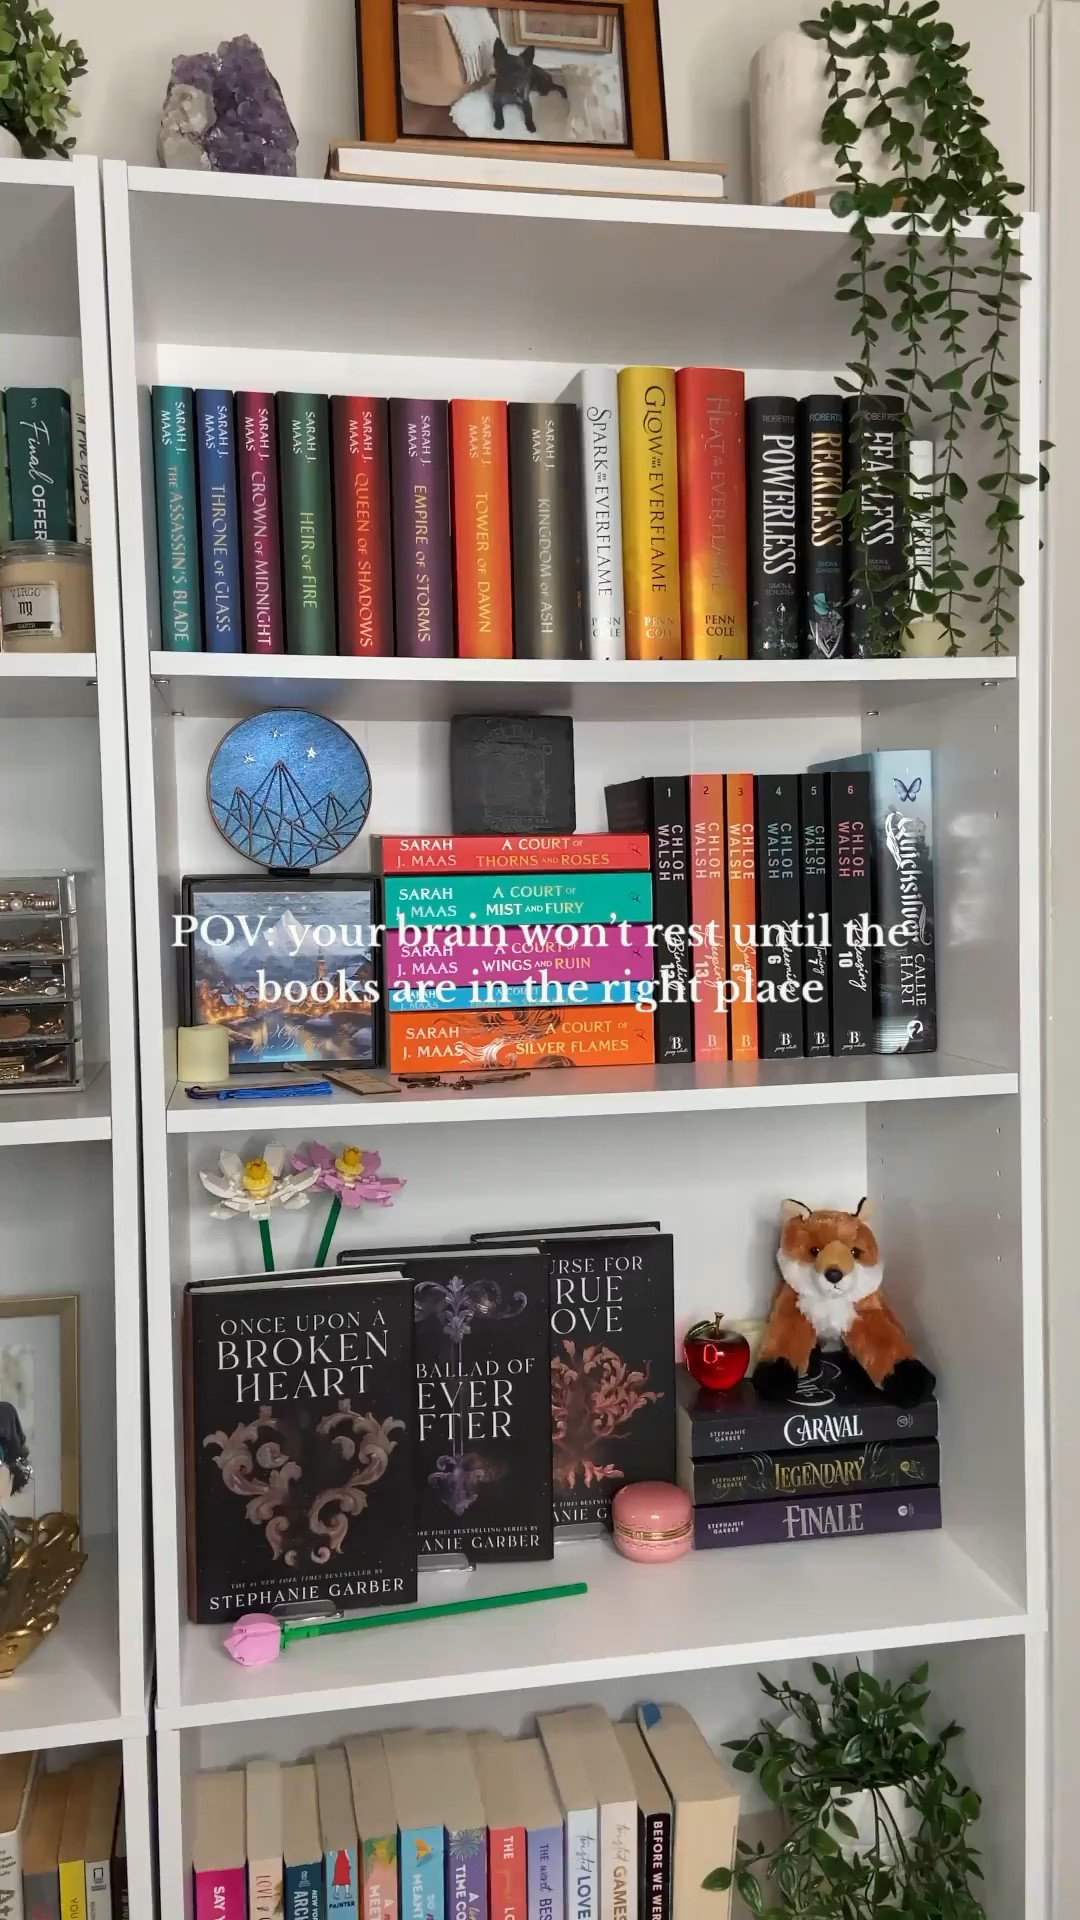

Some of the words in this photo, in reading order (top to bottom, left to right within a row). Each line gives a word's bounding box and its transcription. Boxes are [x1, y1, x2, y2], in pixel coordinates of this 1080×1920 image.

[161, 410, 172, 446] MAAS
[175, 402, 186, 442] SARAH
[205, 414, 216, 449] MAAS
[218, 406, 229, 446] SARAH
[245, 416, 256, 452] MAAS
[258, 408, 270, 449] SARAH
[292, 420, 303, 455] MAAS
[306, 412, 317, 451] SARAH
[349, 420, 360, 455] MAAS
[362, 412, 373, 451] SARAH
[420, 416, 432, 454] SARAH
[482, 416, 492, 456] SARAH
[586, 406, 612, 471] SPARK
[643, 386, 666, 456] GLOW
[20, 420, 54, 484] Final
[175, 447, 187, 455] J.
[217, 450, 229, 459] J.
[258, 452, 270, 461] J.
[408, 423, 418, 458] MAAS
[468, 424, 479, 459] MAAS
[532, 428, 542, 463] MAAS
[545, 420, 555, 459] SARAH
[305, 455, 317, 464] J.
[362, 454, 373, 463] J.
[168, 465, 178, 488] THE
[811, 432, 844, 547] RECKLESS
[32, 484, 48, 540] OFFER
[252, 471, 268, 538] CROWN
[354, 472, 370, 532] QUEEN
[414, 485, 429, 545] EMPIRE
[762, 434, 796, 575] POWERLESS
[170, 490, 187, 584] ASSASSIN'S
[212, 484, 228, 556] THRONE
[300, 512, 315, 550] HEIR
[476, 492, 490, 552] TOWER
[649, 472, 667, 593] EVERFLAME
[538, 498, 552, 578] KINGDOM
[595, 486, 613, 596] EVERFLAME
[9, 587, 42, 598] VIRGO
[214, 582, 231, 632] GLASS
[254, 560, 271, 646] MIDNIGHT
[302, 576, 318, 609] FIRE
[358, 561, 373, 647] SHADOWS
[416, 574, 431, 642] STORMS
[478, 582, 492, 633] DAWN
[173, 590, 189, 642] BLADE
[540, 602, 554, 633] ASH
[706, 614, 735, 625] PENN
[706, 626, 735, 637] COLE
[704, 786, 709, 795] 2
[738, 788, 744, 797] 3
[776, 786, 782, 796] 4
[811, 786, 817, 796] 5
[848, 785, 854, 795] 6
[400, 838, 453, 851] SARAH
[411, 855, 457, 867] MAAS
[476, 854, 539, 868] THORNS
[560, 854, 610, 866] ROSES
[502, 839, 513, 851] A
[518, 837, 571, 851] COURT
[658, 824, 671, 881] WALSH
[672, 824, 684, 881] CHLOE
[694, 822, 707, 879] WALSH
[708, 822, 721, 879] CHLOE
[729, 824, 742, 880] WALSH
[742, 824, 755, 880] CHLOE
[768, 823, 780, 879] WALSH
[780, 823, 793, 879] CHLOE
[804, 826, 816, 875] WALSH
[815, 826, 826, 875] CHLOE
[838, 822, 851, 877] WALSH
[852, 822, 865, 877] CHLOE
[398, 888, 453, 901] SARAH
[486, 903, 523, 916] MIST
[525, 905, 543, 913] AND
[546, 902, 584, 914] FURY
[492, 886, 505, 899] A
[510, 885, 563, 899] COURT
[411, 905, 457, 918] MAAS
[412, 962, 459, 975] MAAS
[482, 959, 532, 972] WINGS
[555, 957, 591, 970] RUIN
[694, 961, 709, 977] 13
[768, 955, 782, 965] 6
[838, 952, 853, 968] 10
[900, 955, 916, 1006] HART
[914, 953, 927, 1007] CALLIE
[406, 1026, 459, 1040] SARAH
[545, 1023, 557, 1036] A
[562, 1020, 612, 1034] COURT
[418, 1043, 465, 1058] MAAS
[515, 1042, 566, 1055] SILVER
[570, 1040, 629, 1053] FLAMES
[604, 1256, 644, 1273] FOR
[220, 1316, 286, 1336] ONCE
[296, 1312, 361, 1333] UPON
[372, 1310, 386, 1326] A
[218, 1330, 389, 1371] BROKEN
[416, 1358, 499, 1379] BALLAD
[508, 1357, 536, 1374] OF
[236, 1364, 373, 1404] HEART
[418, 1380, 514, 1410] EVER
[710, 1429, 746, 1438] STEPHANIE
[784, 1414, 863, 1447] CARAVAL
[774, 1456, 865, 1494] LEGENDARY
[454, 1526, 501, 1534] BESTSELLING
[708, 1520, 745, 1531] STEPHANIE
[783, 1502, 864, 1539] FINALE
[471, 1534, 540, 1549] GARBER
[325, 1568, 371, 1580] BESTSELLER
[210, 1586, 319, 1610] STEPHANIE
[328, 1578, 405, 1598] GARBER
[504, 1836, 514, 1860] THE
[540, 1844, 549, 1861] THE
[654, 1821, 663, 1869] BEFORE
[256, 1875, 271, 1900] LOVE
[456, 1864, 467, 1899] TIME
[540, 1866, 553, 1892] worst
[614, 1866, 627, 1920] GAMES
[652, 1872, 663, 1892] WE
[214, 1886, 226, 1911] SAY
[412, 1874, 424, 1920] MEANT
[578, 1876, 591, 1920] LOVE
